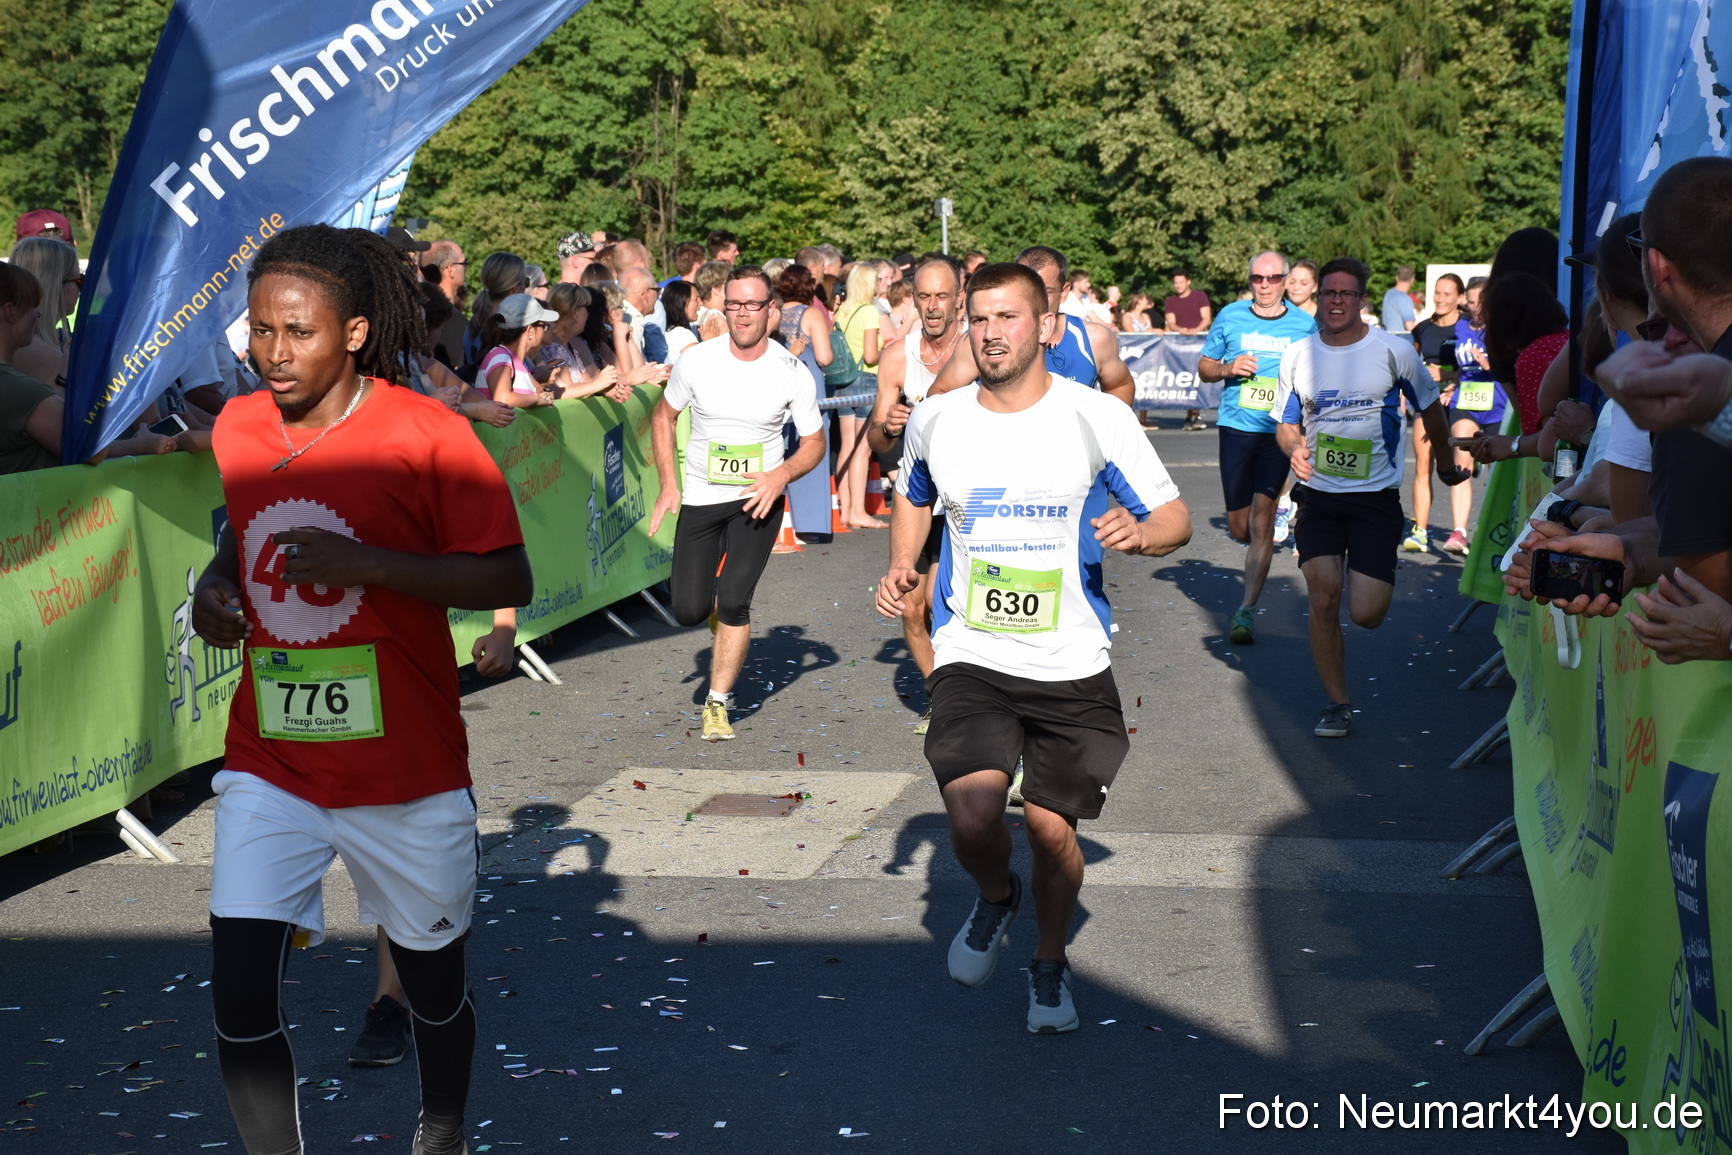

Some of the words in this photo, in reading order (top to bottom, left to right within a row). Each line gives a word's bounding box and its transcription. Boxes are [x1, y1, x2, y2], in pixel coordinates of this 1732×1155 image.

[375, 23, 457, 93] Druck
[456, 0, 500, 27] un
[1250, 387, 1275, 402] 790
[1464, 391, 1488, 402] 1356
[719, 458, 749, 473] 701
[1325, 449, 1358, 467] 632
[958, 487, 1069, 534] FORSTER
[57, 498, 119, 547] Firmen
[30, 566, 87, 629] laufen
[986, 588, 1039, 616] 630
[985, 612, 1006, 622] Seger
[266, 662, 304, 673] firmenlauf
[309, 671, 334, 680] 2018
[277, 682, 349, 715] 776
[283, 725, 329, 734] Hammerbacher
[331, 725, 352, 733] GmbH
[285, 716, 312, 728] Frezgi
[315, 716, 347, 726] Guahs
[428, 923, 455, 933] adidas
